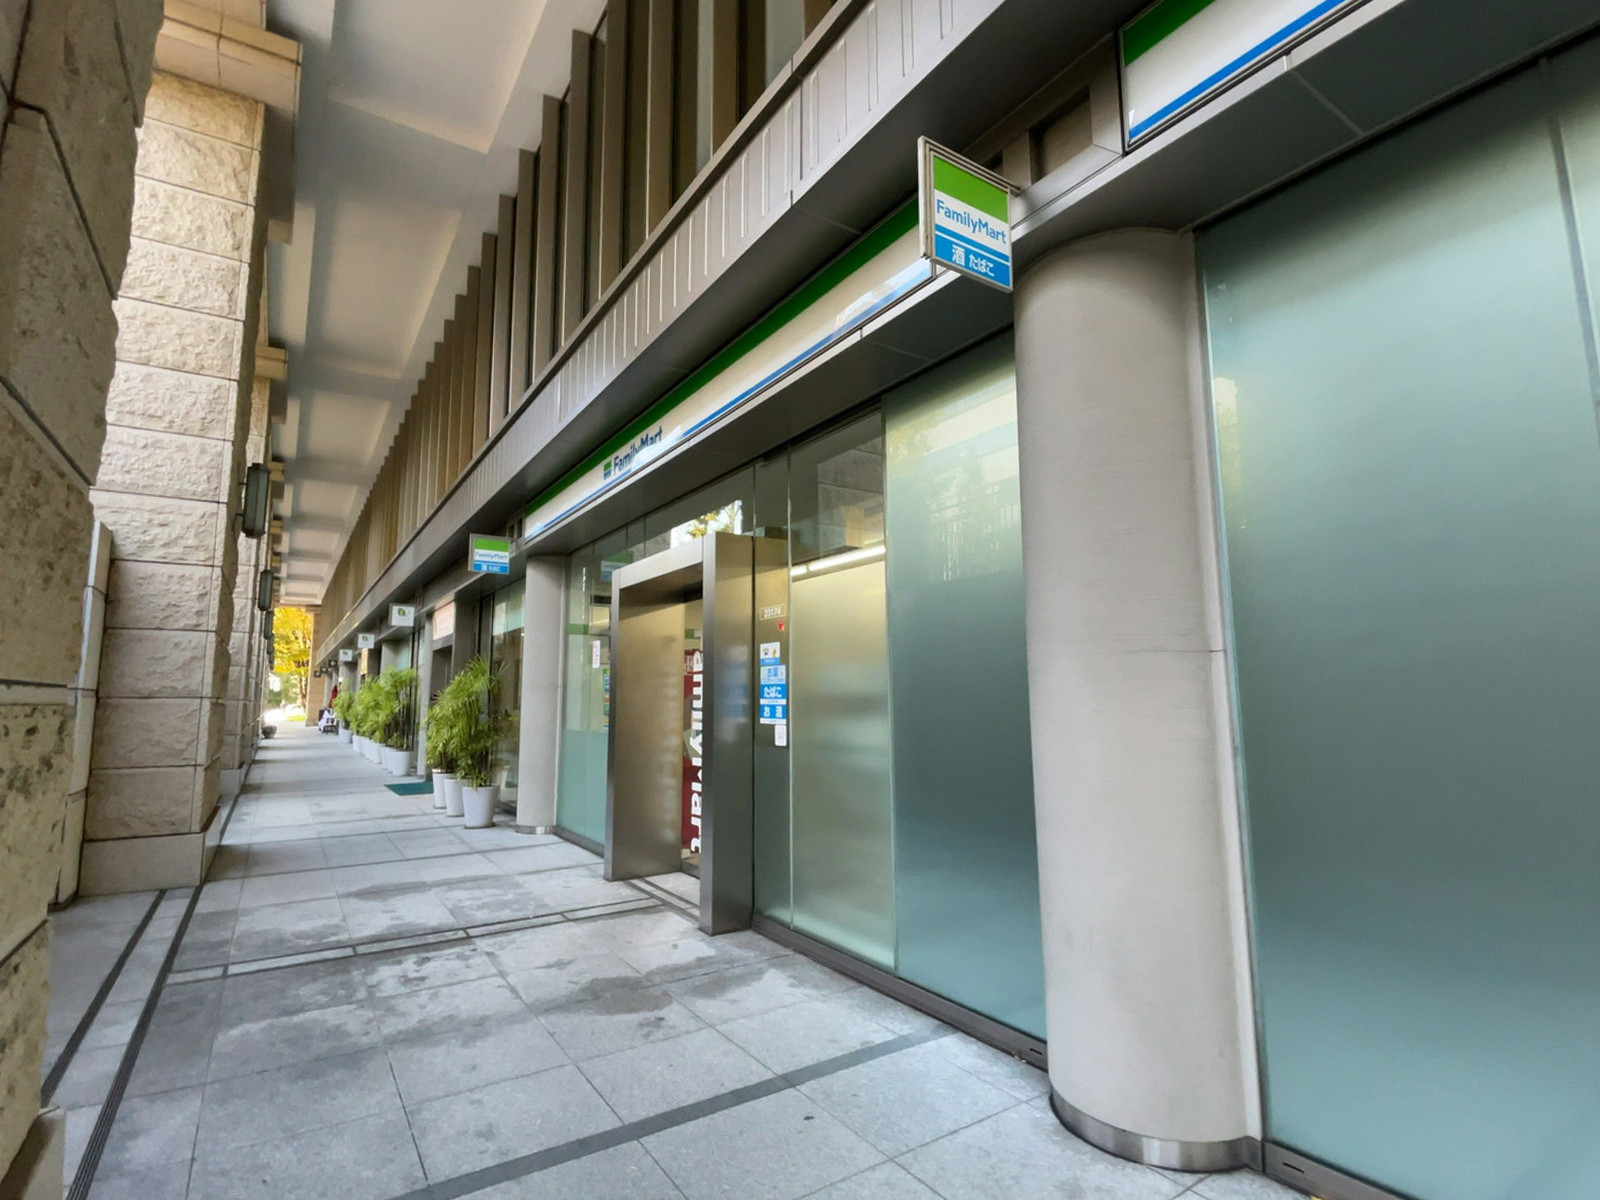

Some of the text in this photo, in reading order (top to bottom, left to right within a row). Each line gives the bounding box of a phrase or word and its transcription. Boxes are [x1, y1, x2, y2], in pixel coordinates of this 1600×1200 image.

[936, 198, 1007, 245] FamilyMart
[969, 254, 995, 277] たばこ
